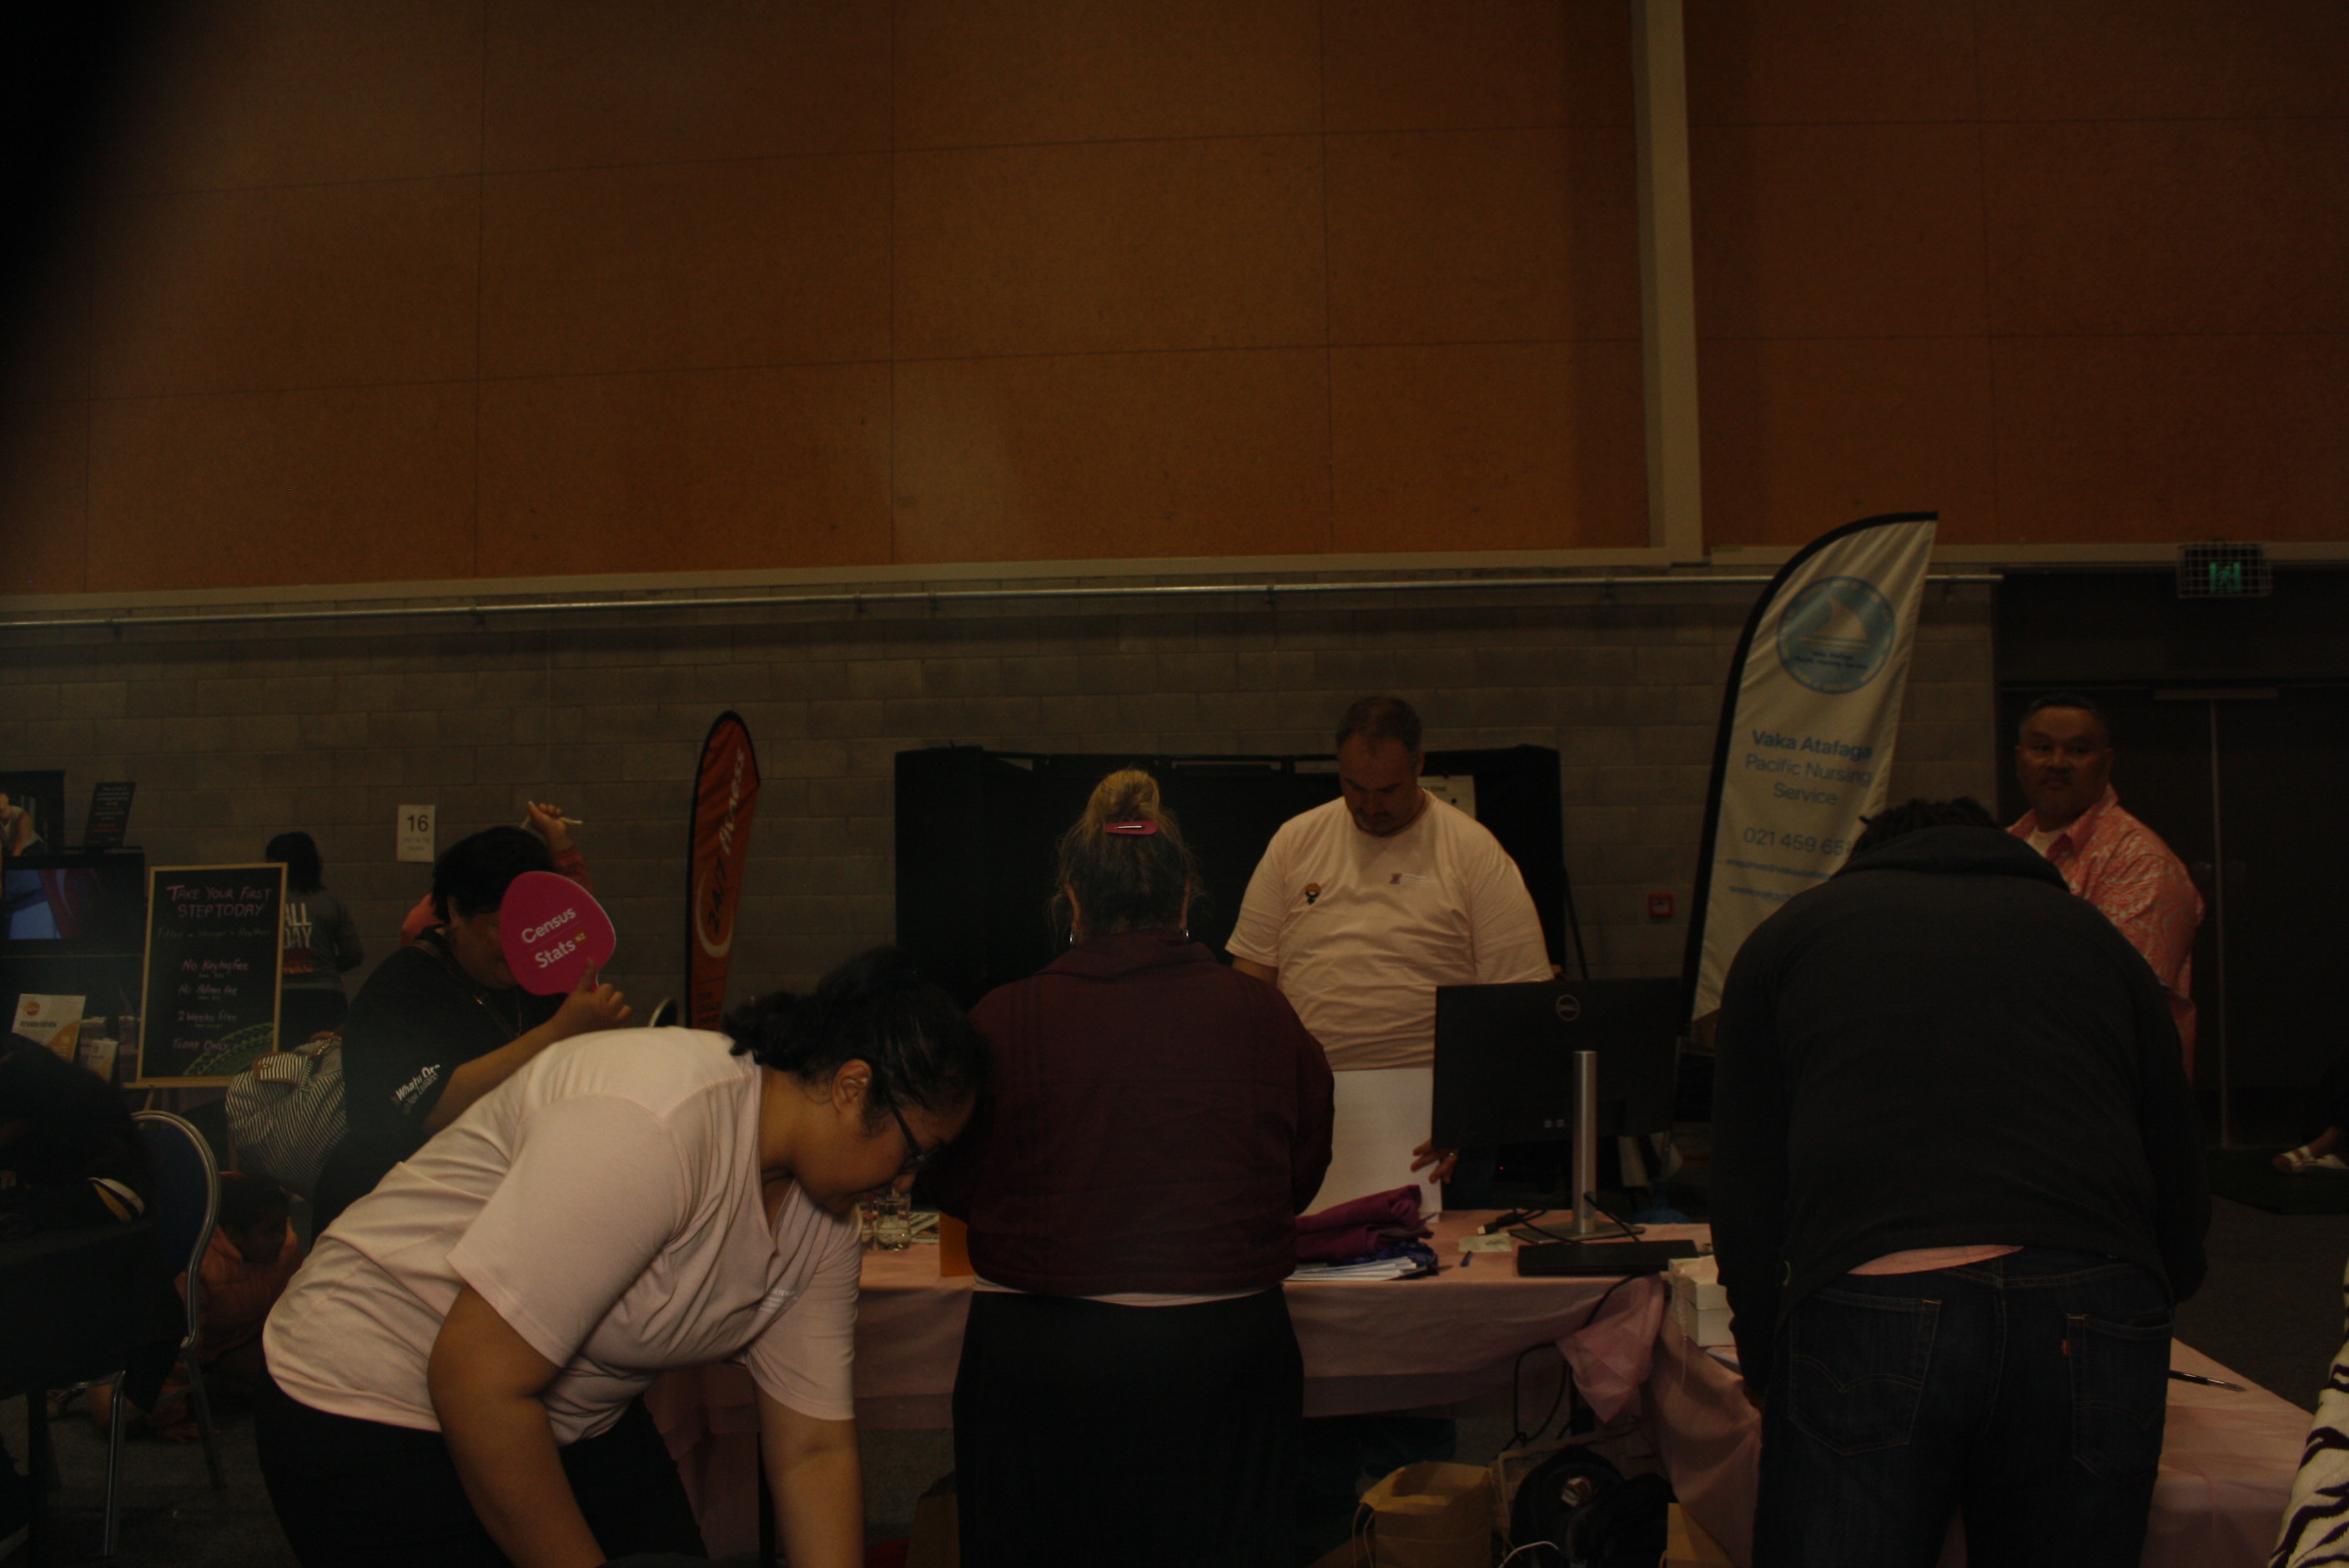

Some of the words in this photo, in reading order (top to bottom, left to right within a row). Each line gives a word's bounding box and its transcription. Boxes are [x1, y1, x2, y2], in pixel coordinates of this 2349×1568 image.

[1753, 730, 1797, 750] Vaka
[1802, 737, 1873, 761] Atafaga
[1745, 753, 1801, 776] Pacific
[1806, 762, 1873, 787] Nursing
[1774, 782, 1838, 805] Service
[407, 814, 428, 832] 16
[1743, 827, 1776, 847] 021
[1780, 833, 1818, 853] 459
[215, 903, 264, 918] TODAY
[521, 907, 576, 943] Census
[535, 940, 576, 968] Stats
